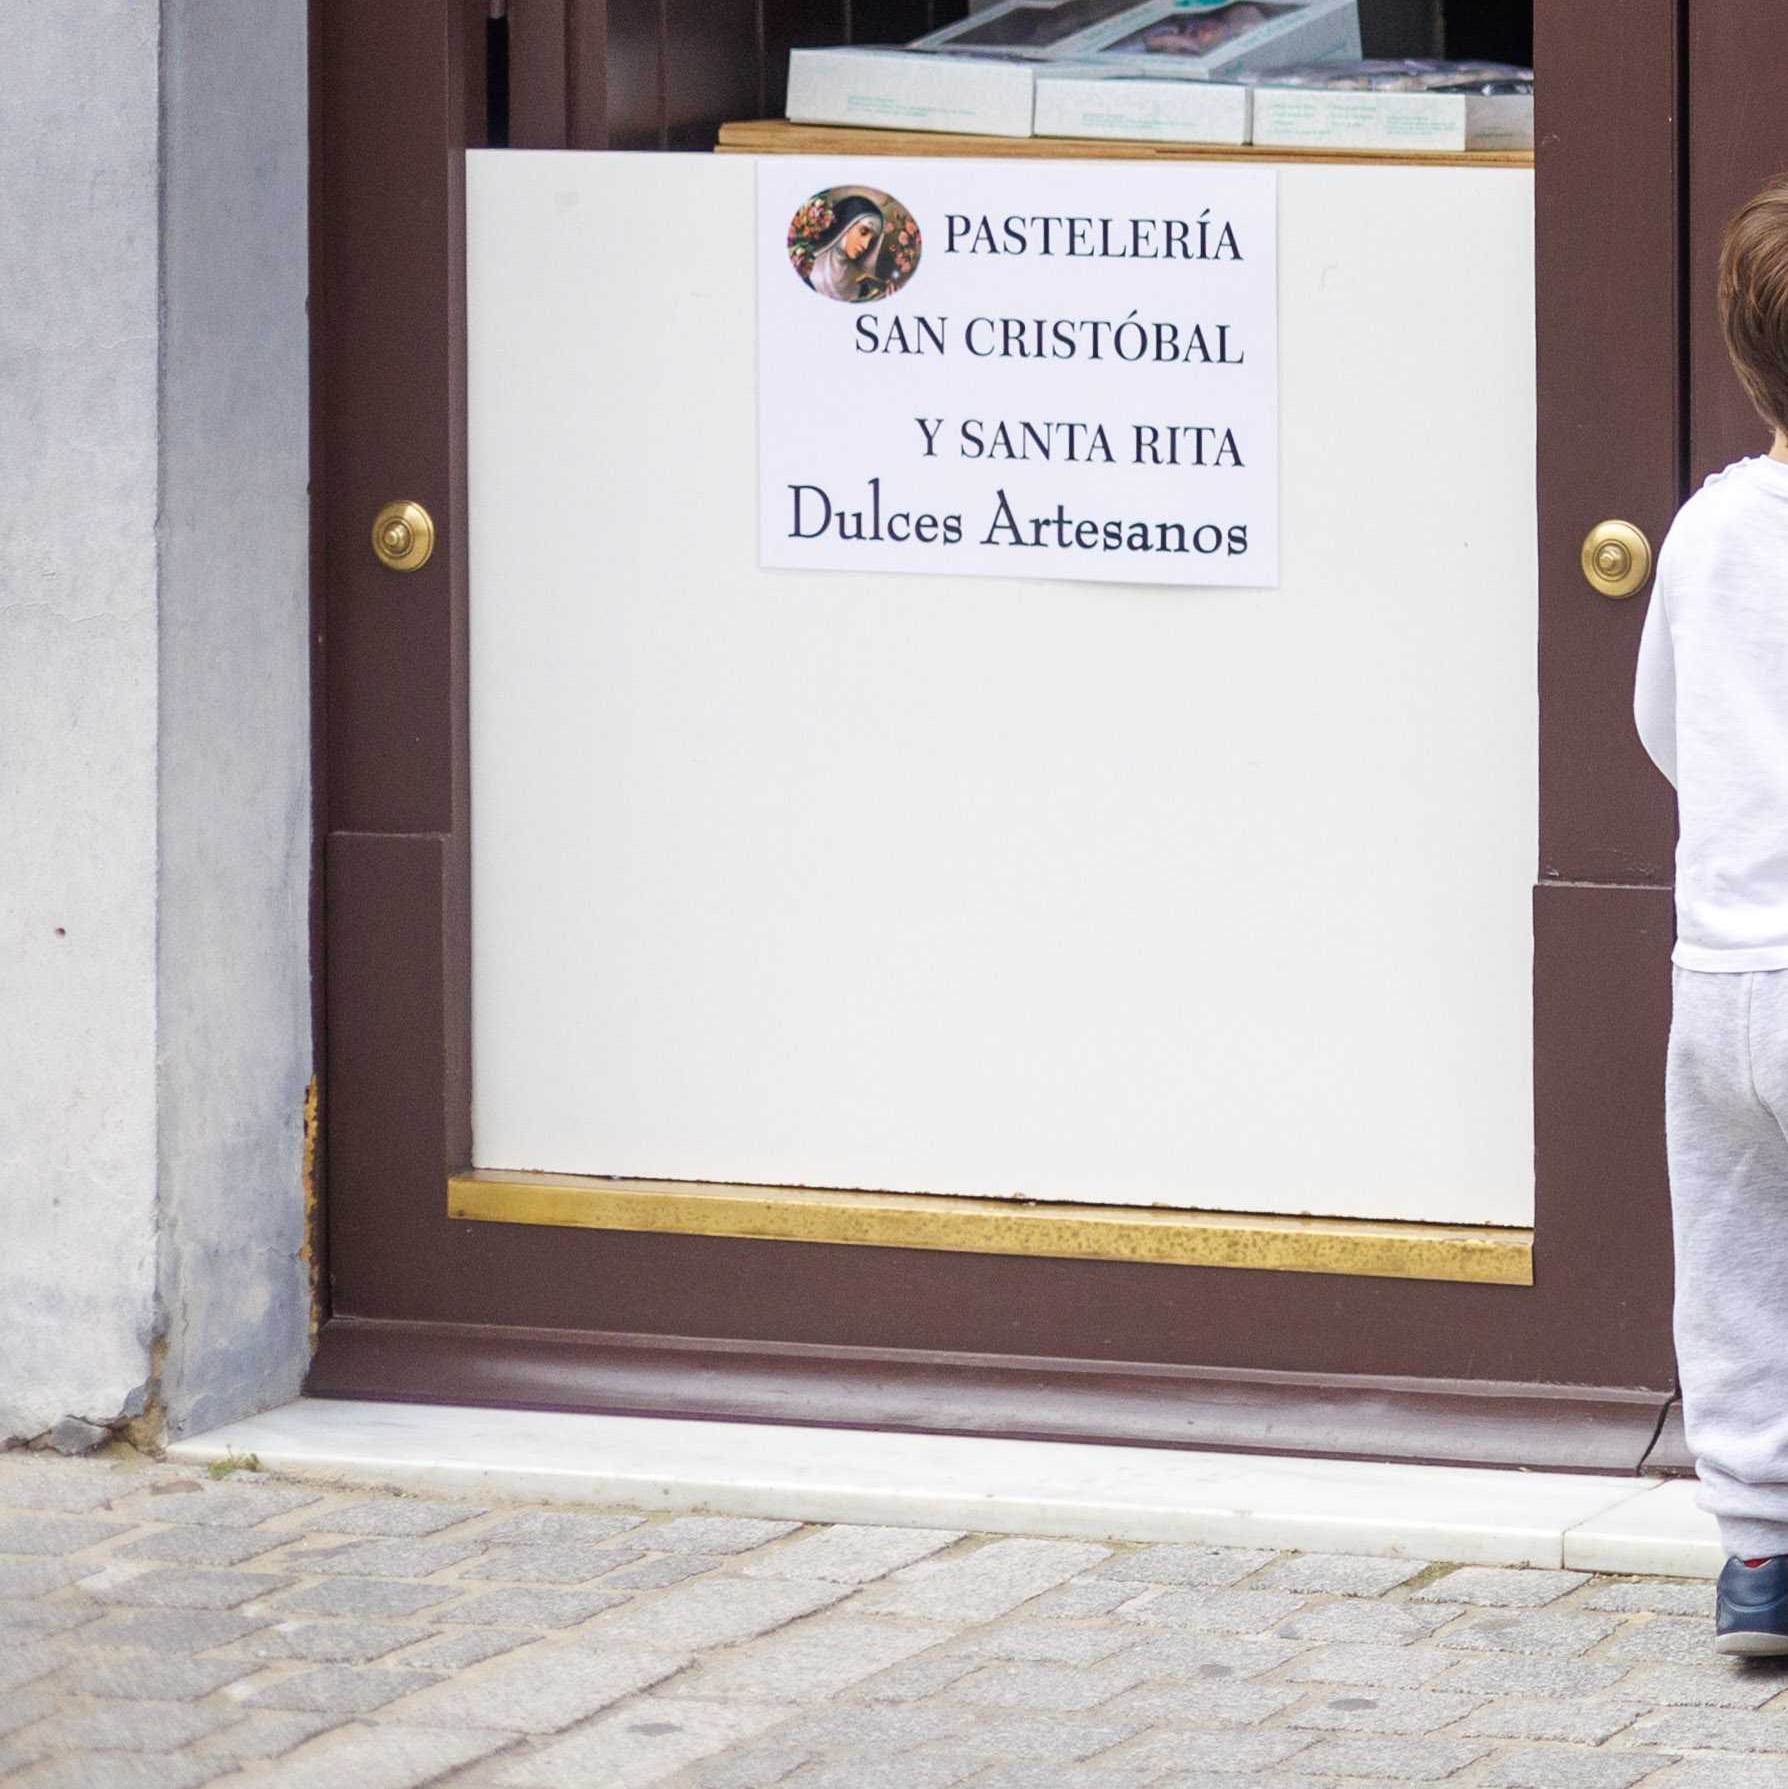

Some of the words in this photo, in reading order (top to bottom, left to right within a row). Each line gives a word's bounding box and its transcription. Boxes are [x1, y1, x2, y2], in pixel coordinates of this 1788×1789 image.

[946, 209, 1243, 260] PASTELERÍA
[856, 315, 946, 354] SAN
[965, 310, 1243, 363] CRISTÓBAL
[916, 419, 943, 455] Y
[962, 420, 1115, 462] SANTA
[1133, 426, 1244, 466] RITA
[788, 478, 962, 545] Dulces
[980, 489, 1247, 555] Artesanos
